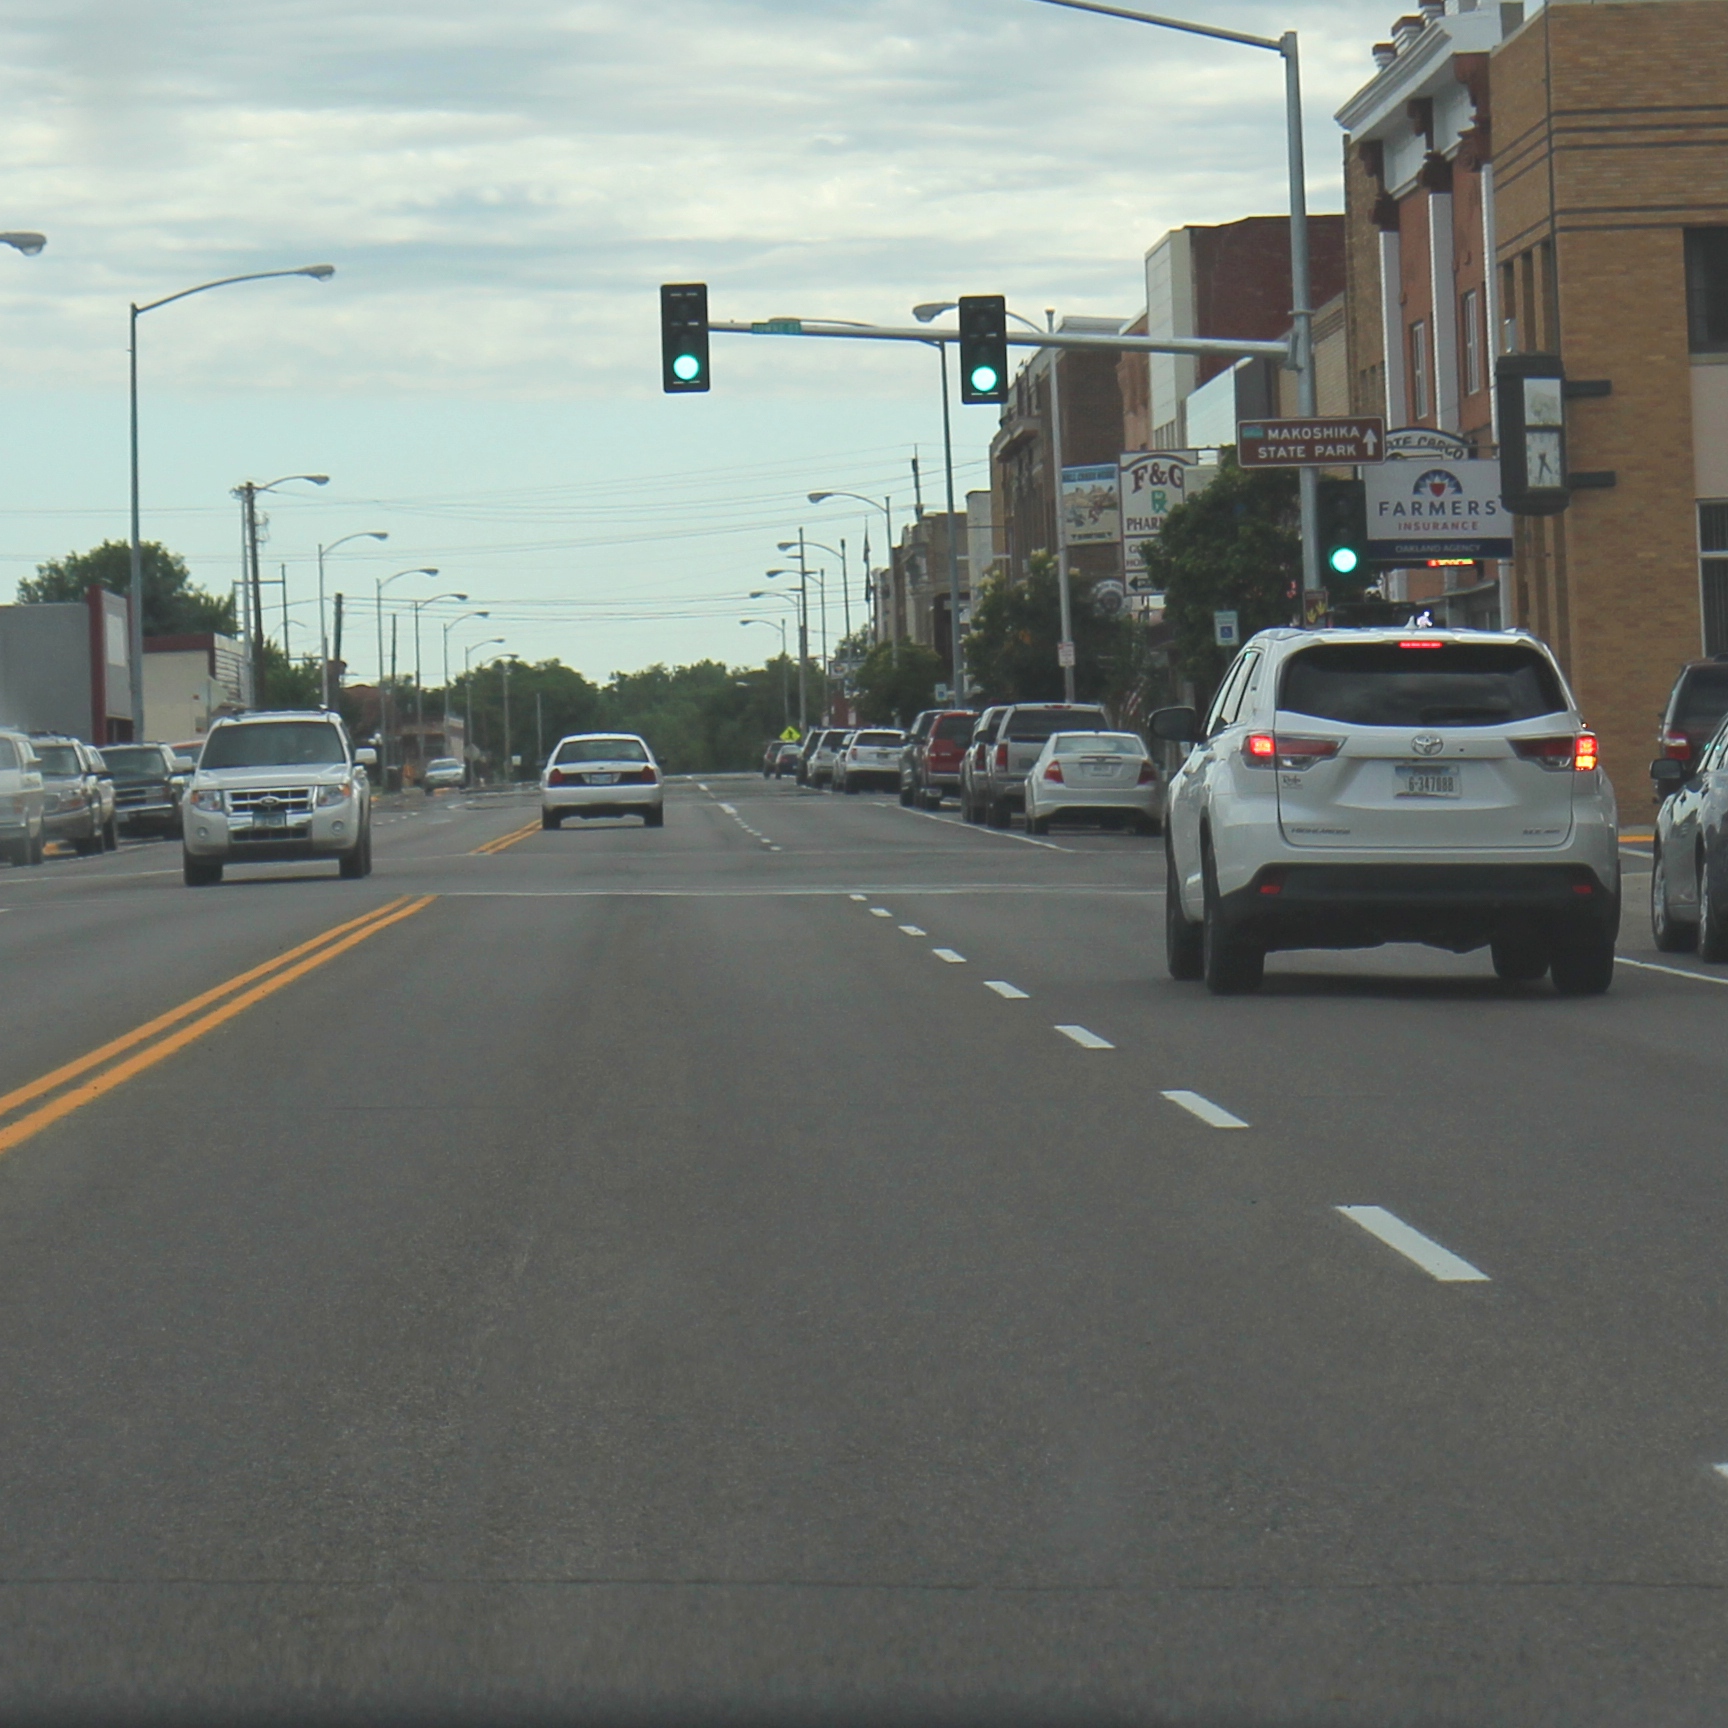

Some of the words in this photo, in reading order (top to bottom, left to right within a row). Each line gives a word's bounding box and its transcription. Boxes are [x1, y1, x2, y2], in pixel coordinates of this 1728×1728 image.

[1267, 426, 1360, 441] MAKOSHIKA
[1258, 446, 1306, 459] STATE
[1315, 444, 1357, 457] PARK
[1132, 461, 1185, 494] F&G
[1378, 500, 1497, 517] FARMERS
[1398, 521, 1479, 531] INSURANCE
[1395, 544, 1441, 553] OAKLAND
[1443, 543, 1481, 552] AGENCY
